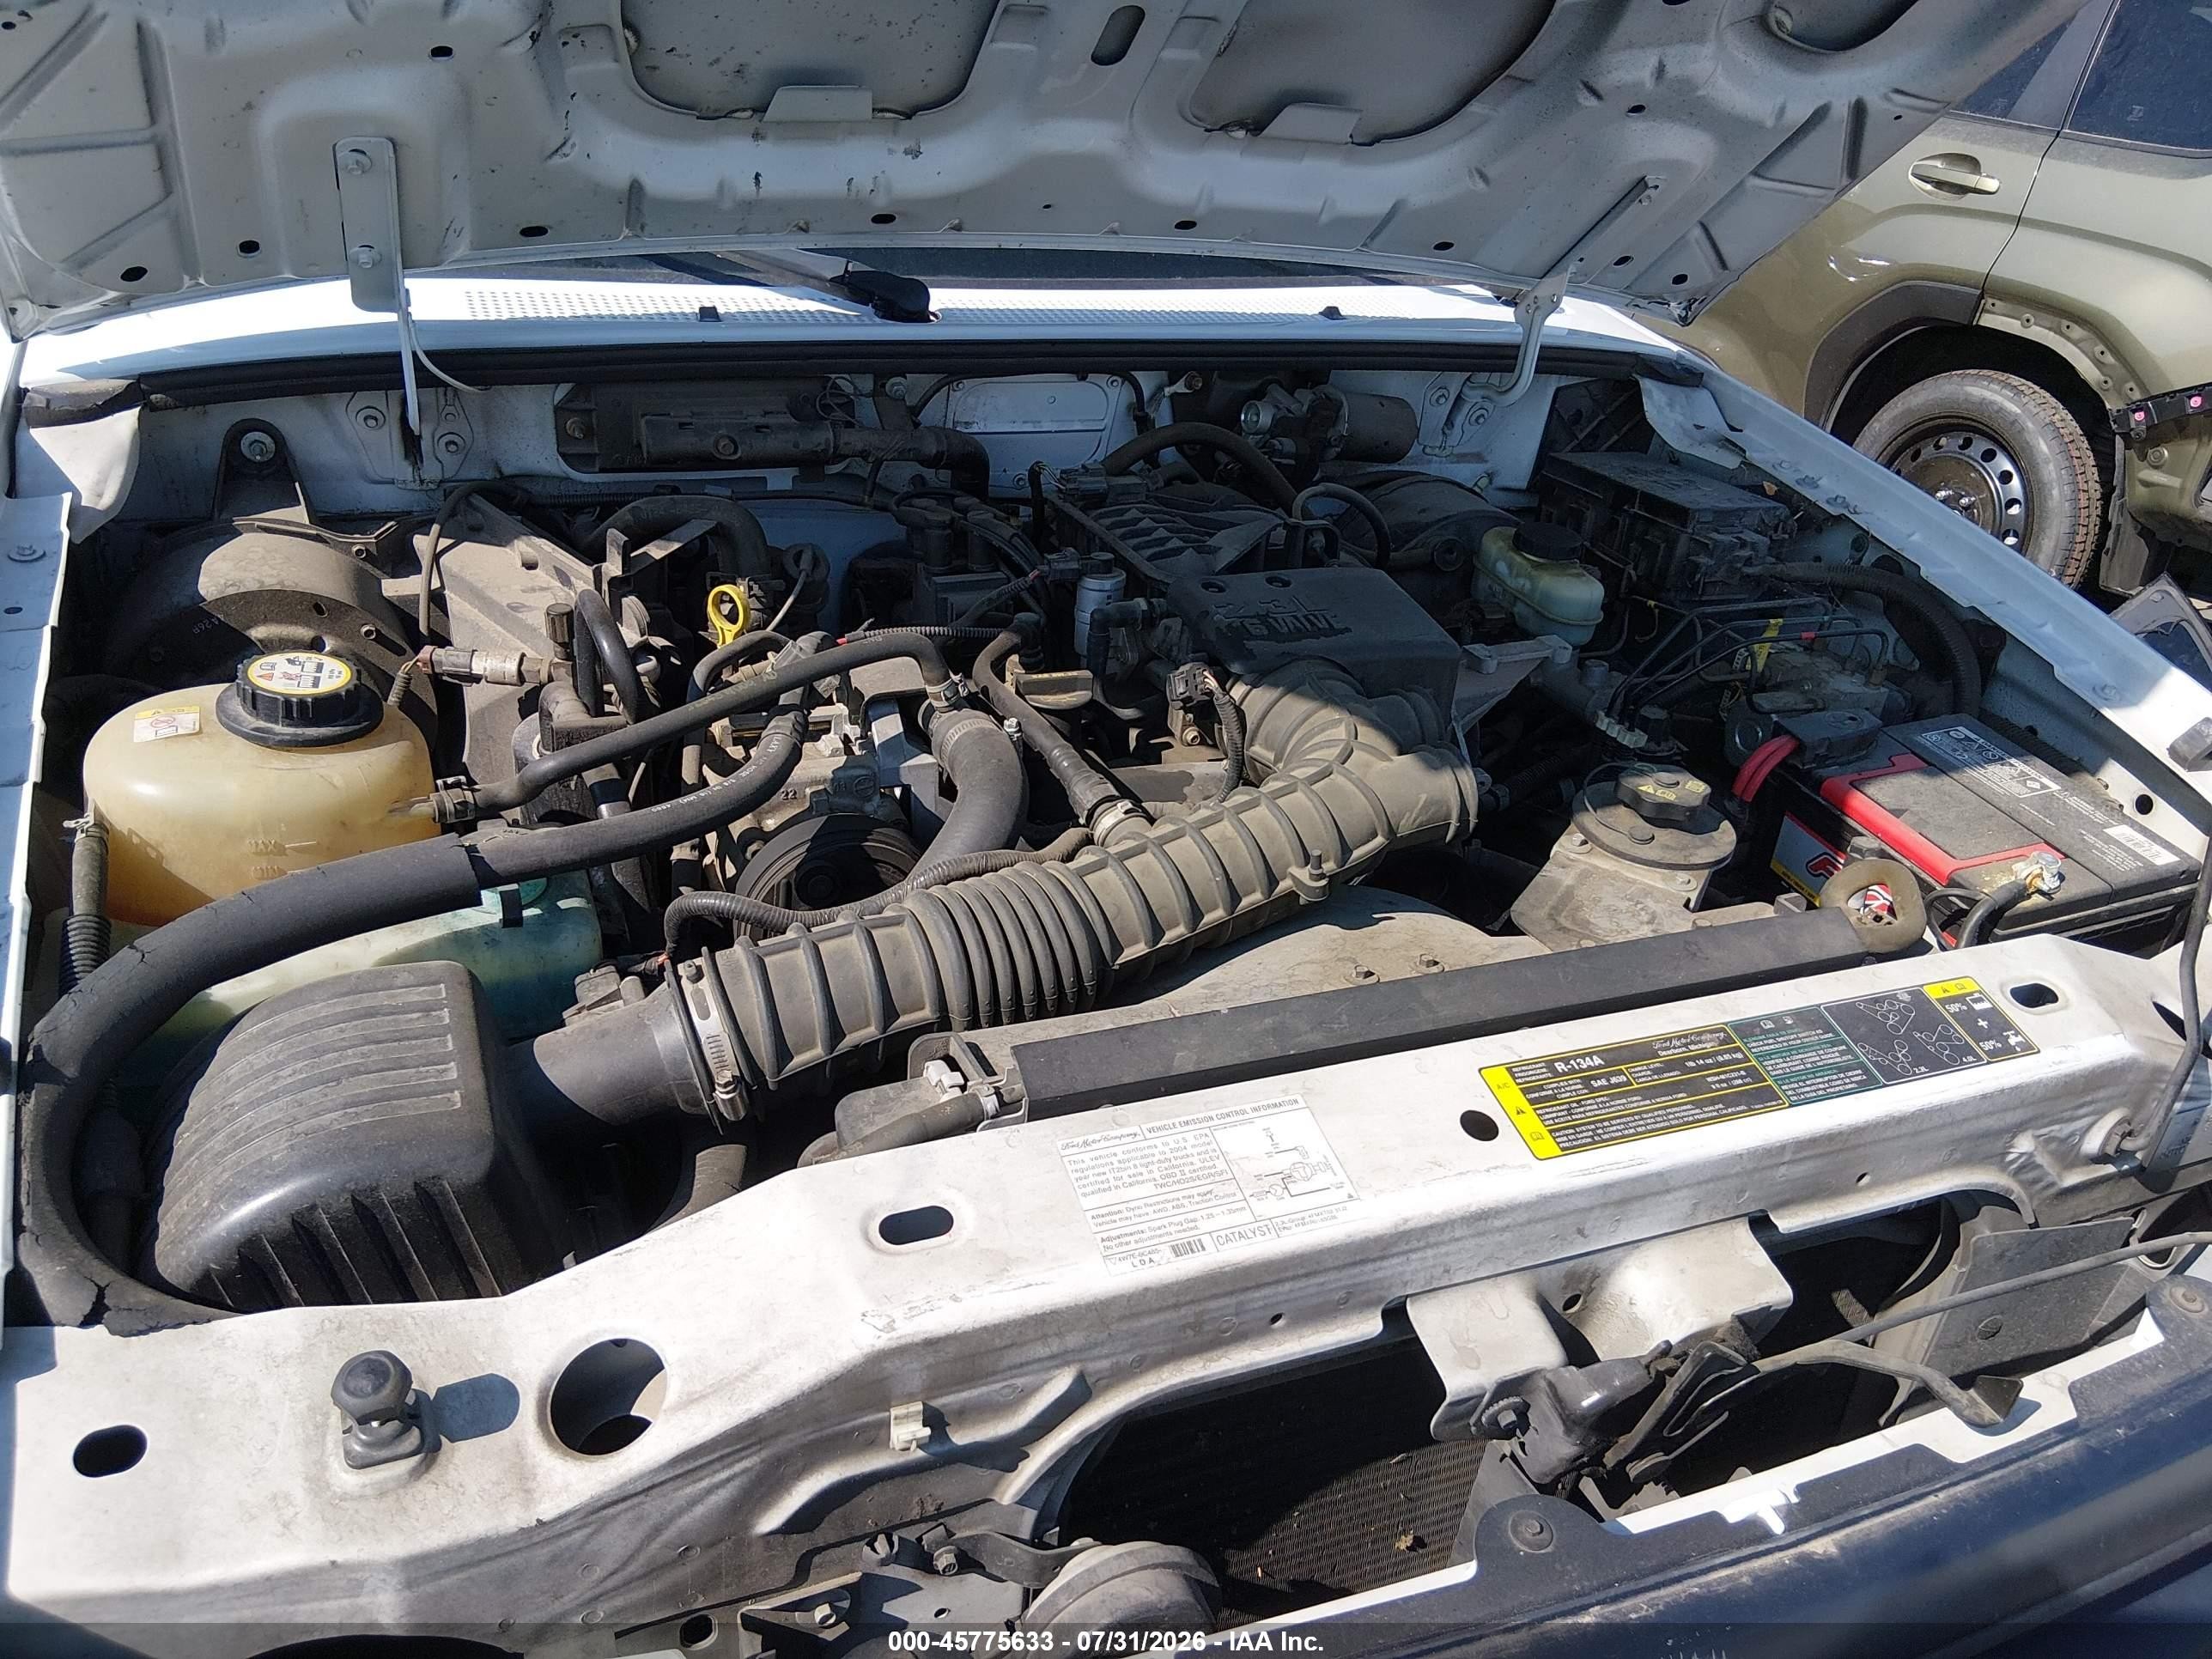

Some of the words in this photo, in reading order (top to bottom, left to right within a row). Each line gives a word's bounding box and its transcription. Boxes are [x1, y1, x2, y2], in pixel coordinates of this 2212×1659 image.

[781, 789, 798, 801] 22
[1943, 1001, 1969, 1012] 50%
[1978, 1039, 2003, 1051] 50%
[1553, 1054, 1606, 1073] R-134A
[1589, 1078, 1609, 1087] SAE
[1607, 1074, 1628, 1084] J639
[1146, 1121, 1178, 1133] VEHICLE
[1177, 1115, 1215, 1127] EMISSION
[1214, 1108, 1249, 1121] CONTROL
[1249, 1097, 1300, 1114] INFORMATION
[1066, 1158, 1085, 1166] This
[1088, 1151, 1118, 1162] vehicle
[1193, 1132, 1210, 1140] EPA
[1198, 1154, 1221, 1164] ULEV
[1214, 1223, 1273, 1246] CATALYST
